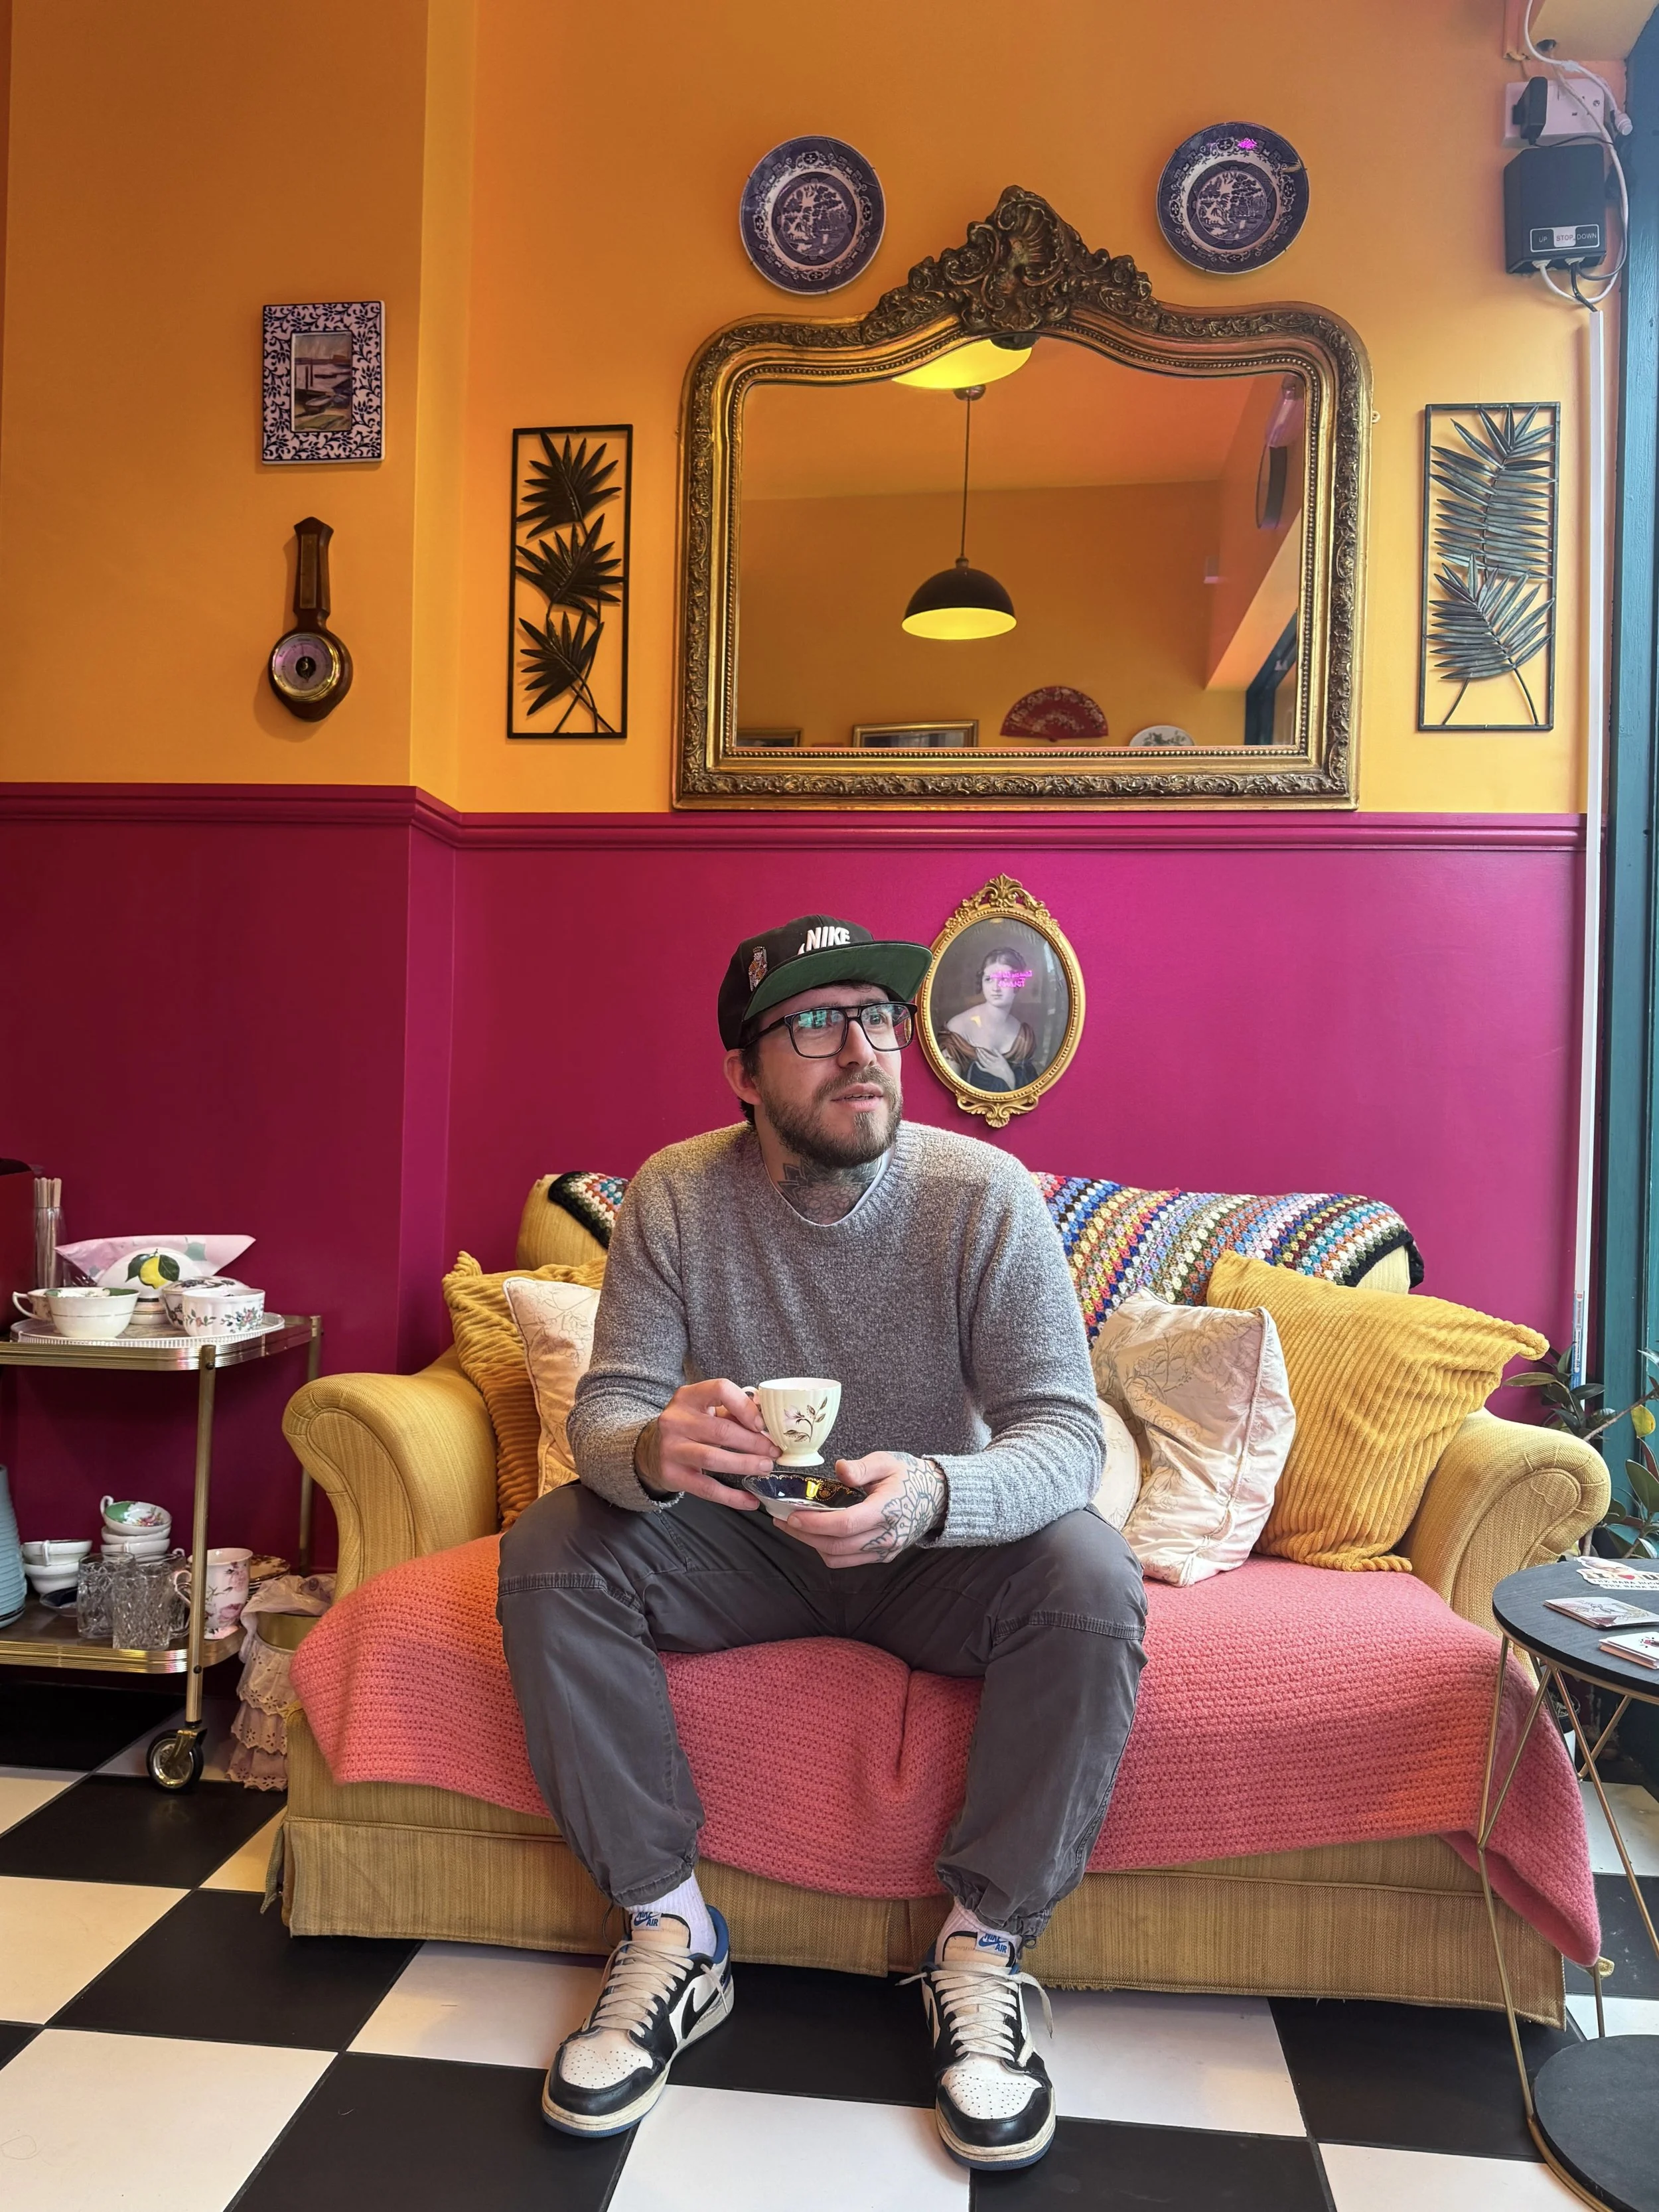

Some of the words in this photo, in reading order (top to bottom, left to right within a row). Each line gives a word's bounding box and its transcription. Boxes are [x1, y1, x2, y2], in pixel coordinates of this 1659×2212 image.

[806, 926, 851, 952] NIKE
[646, 1918, 659, 1927] AIR
[995, 1943, 1007, 1954] AIR
